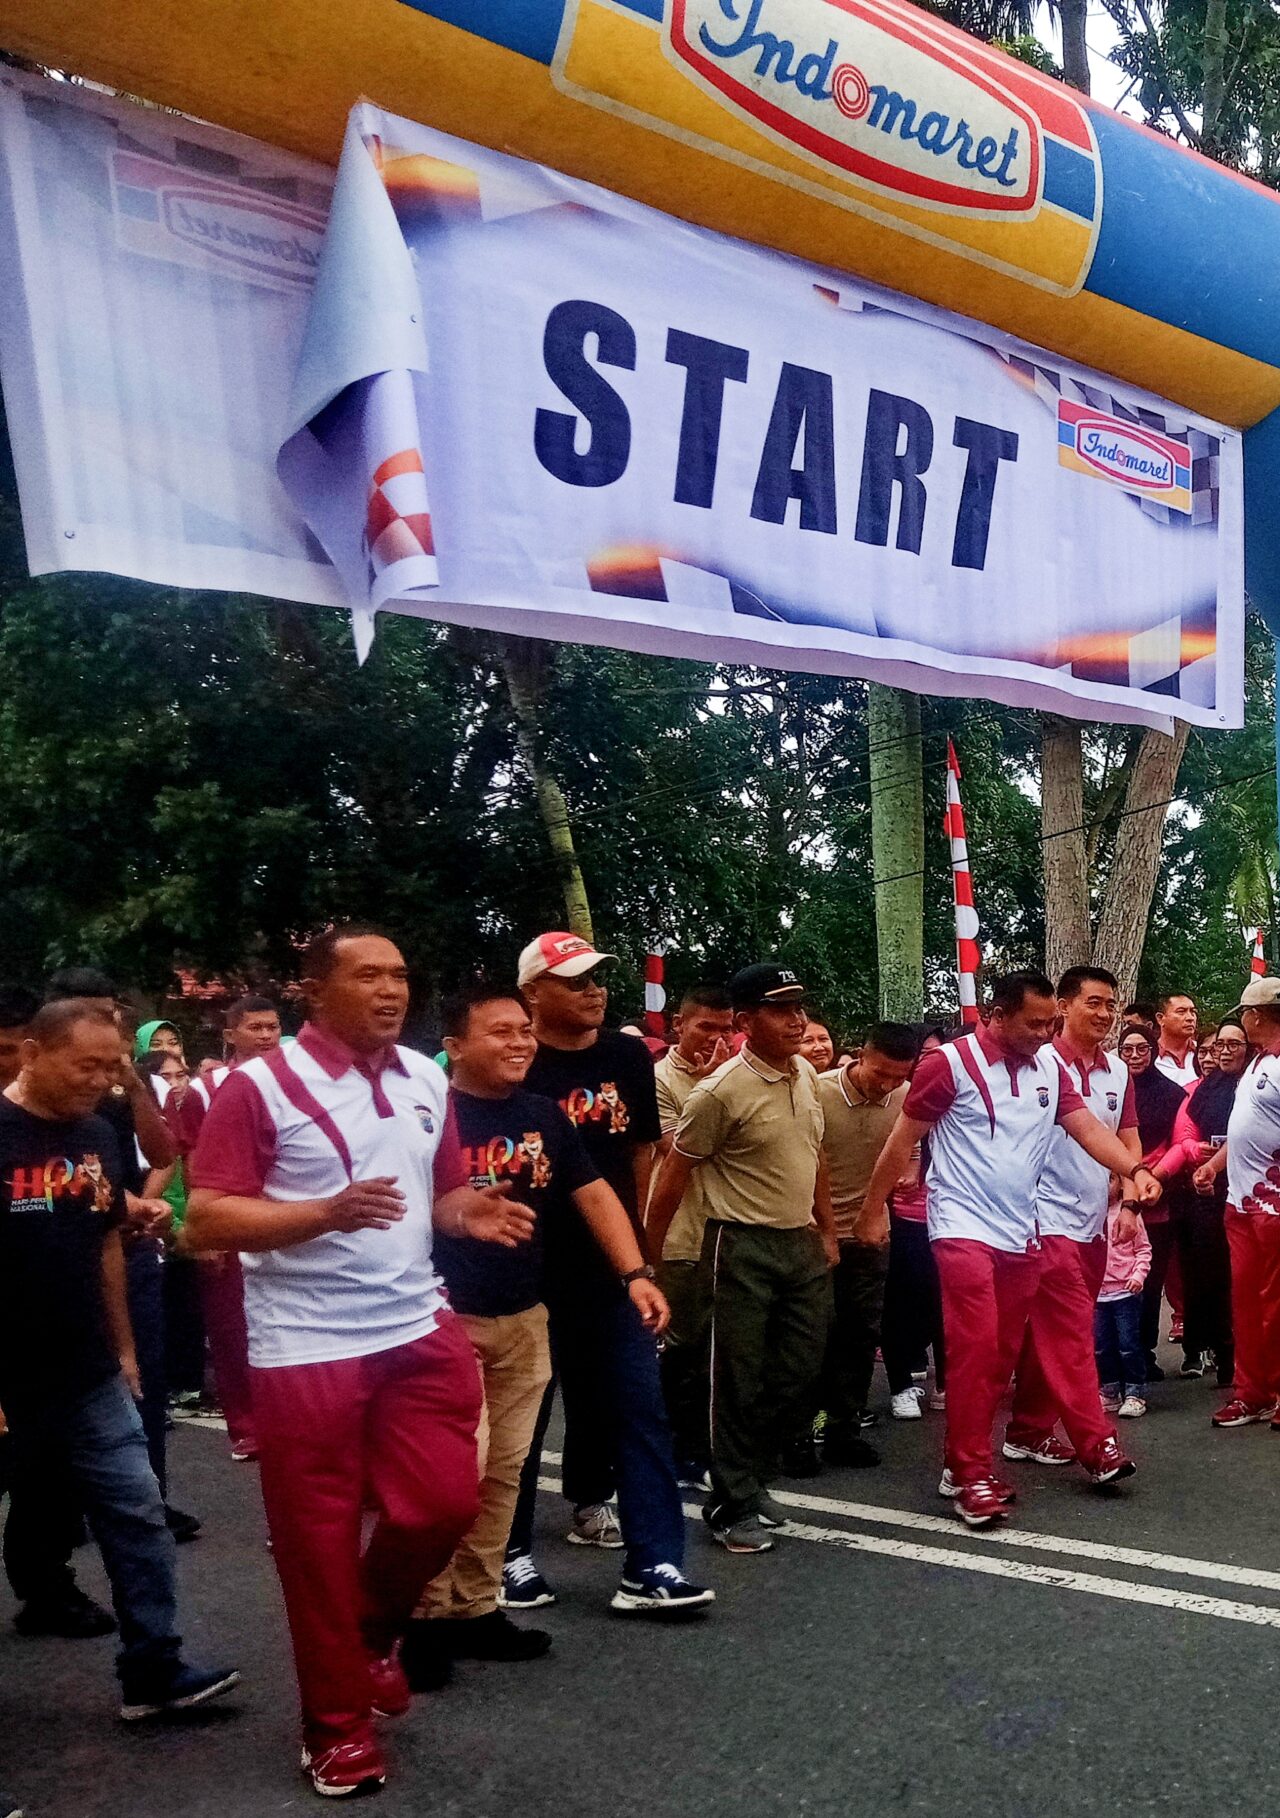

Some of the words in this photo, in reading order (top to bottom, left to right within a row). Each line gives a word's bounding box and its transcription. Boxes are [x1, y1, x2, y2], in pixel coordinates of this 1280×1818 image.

[699, 0, 1017, 186] Indomaret
[534, 299, 1019, 571] START
[1084, 433, 1168, 481] Indomaret
